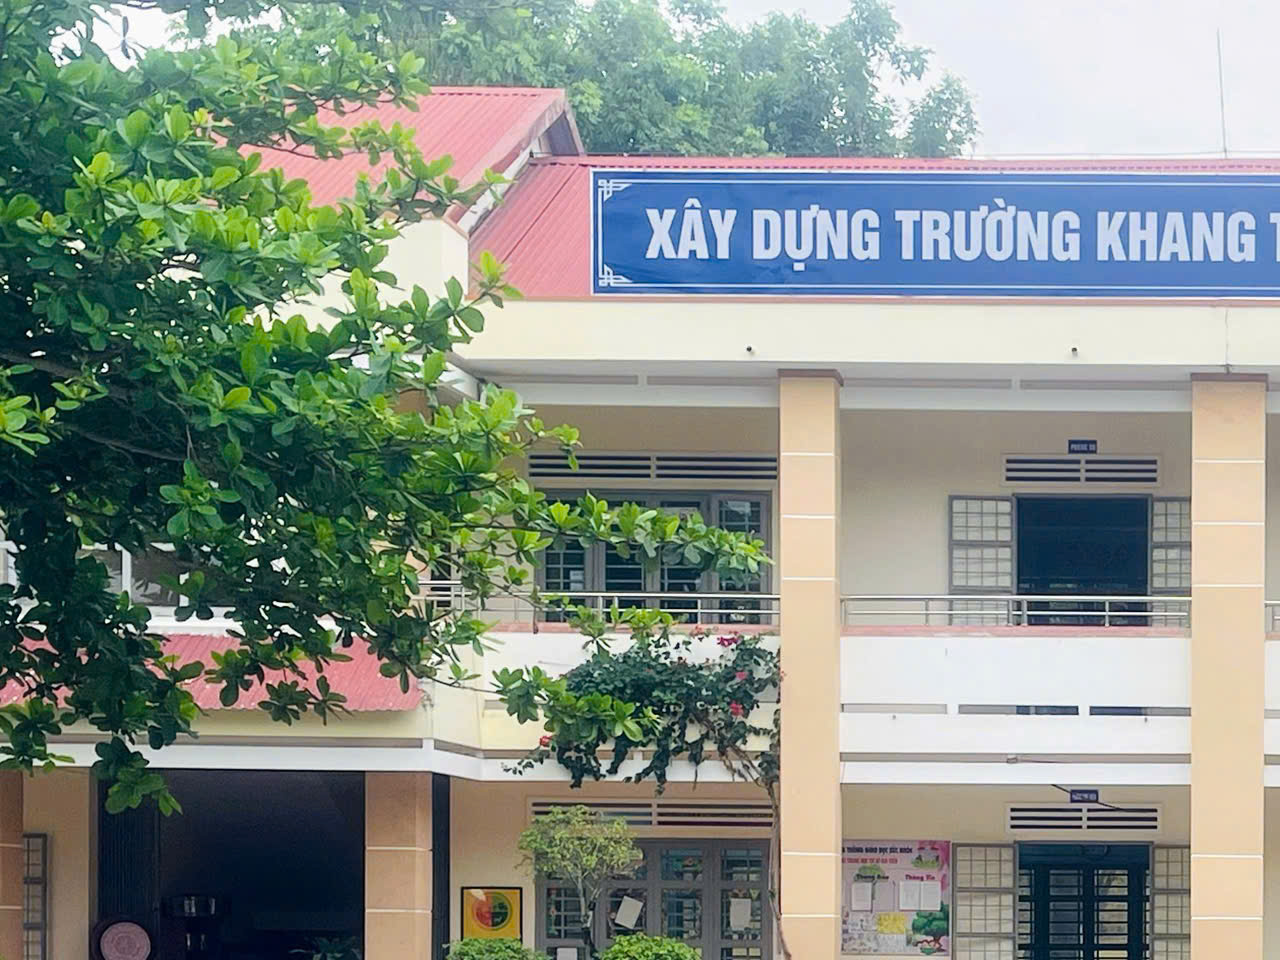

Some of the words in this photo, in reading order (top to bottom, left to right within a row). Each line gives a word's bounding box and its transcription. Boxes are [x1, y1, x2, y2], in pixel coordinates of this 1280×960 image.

[646, 197, 737, 260] XÂY
[752, 204, 881, 271] DỰNG
[896, 198, 1081, 262] TRƯỜNG
[1096, 208, 1257, 263] KHANG
